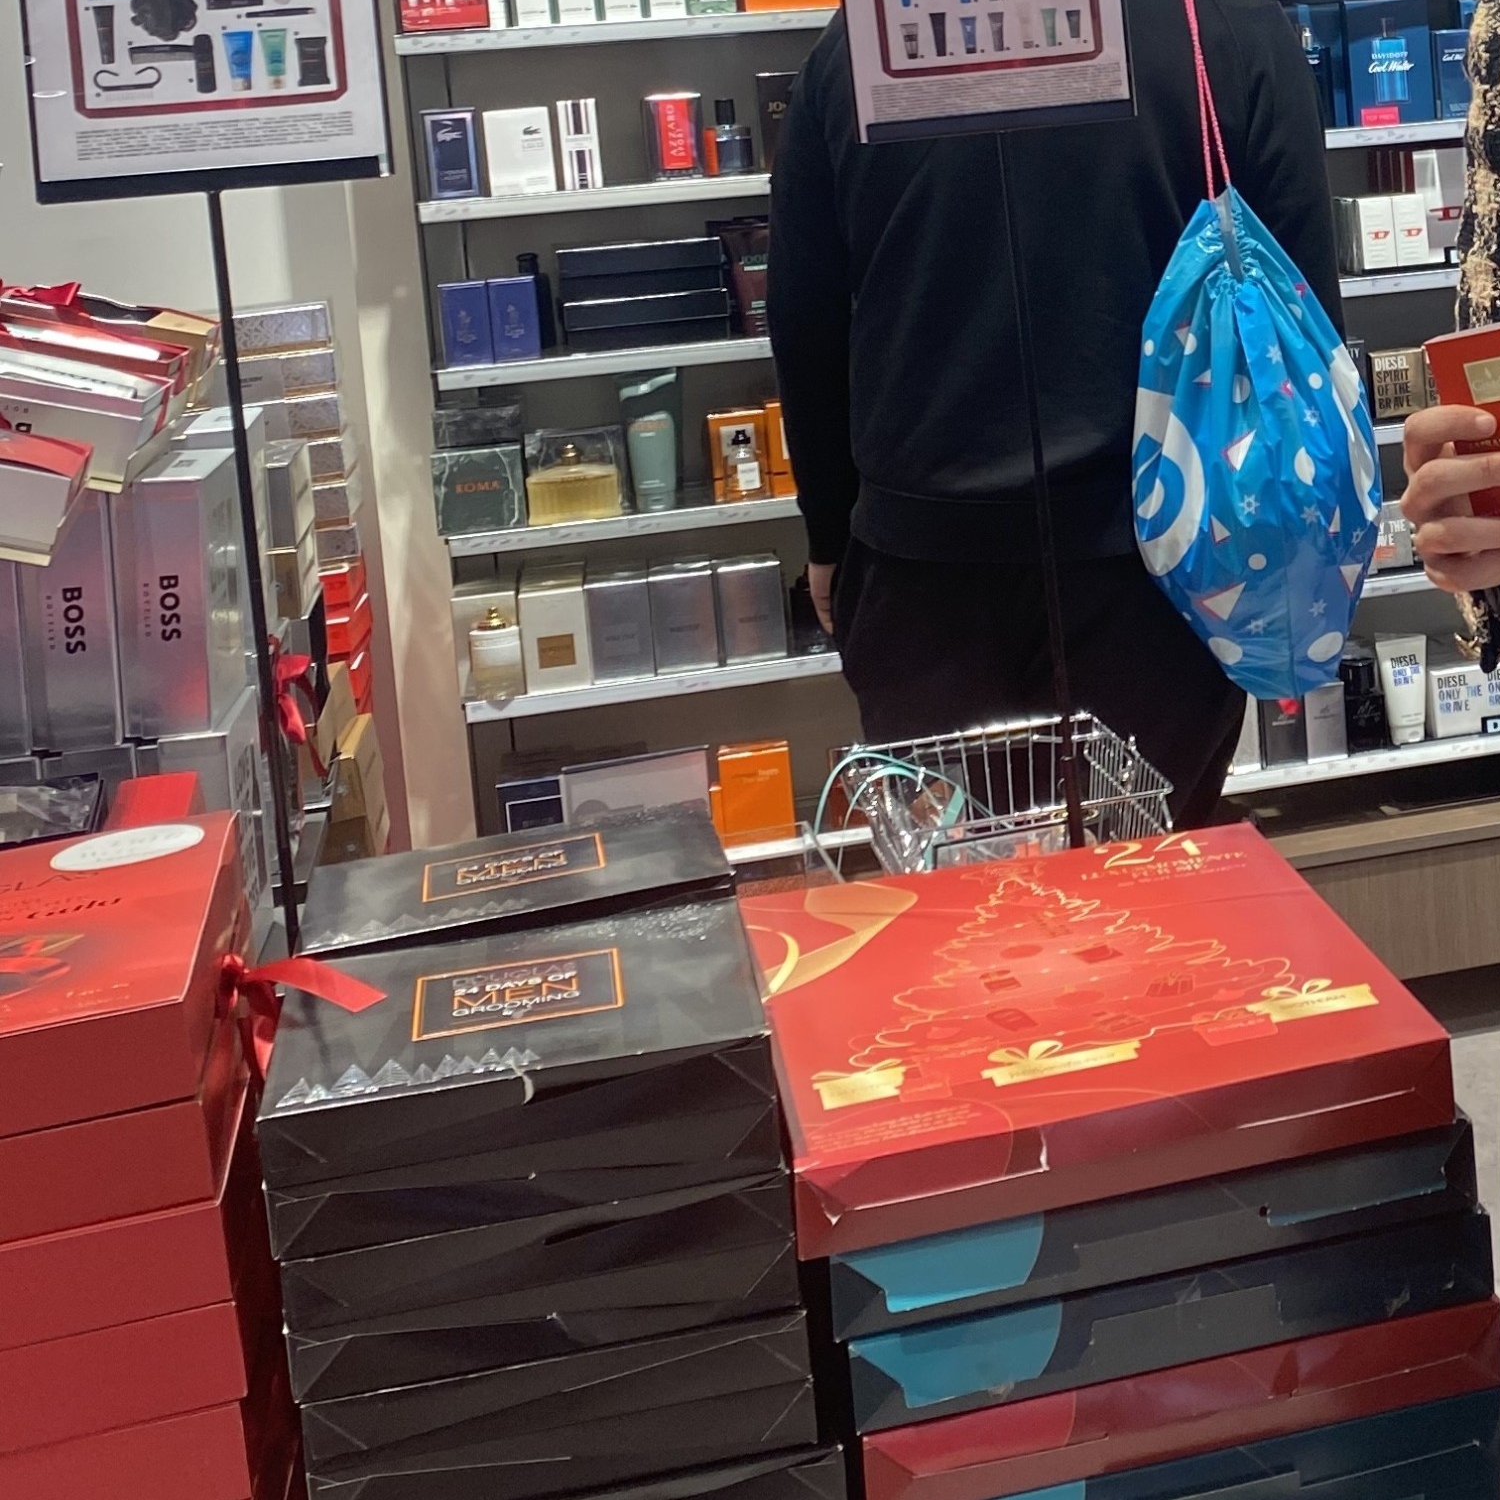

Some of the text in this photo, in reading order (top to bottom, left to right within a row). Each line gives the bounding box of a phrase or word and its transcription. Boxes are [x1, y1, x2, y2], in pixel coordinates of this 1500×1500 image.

[1368, 61, 1415, 74] Cool Water
[666, 103, 678, 157] AZZARO
[1374, 355, 1410, 372] DIESEL
[1376, 368, 1410, 384] SPIRIT
[1377, 381, 1411, 397] OF THE
[1378, 395, 1412, 410] BRAVE
[1388, 519, 1407, 533] THE
[159, 575, 181, 642] BOSS
[62, 586, 86, 654] BOSS
[1390, 654, 1419, 669] DIESEL
[1392, 666, 1421, 678] ONLY THE
[1393, 676, 1414, 687] BRAVE
[1437, 674, 1468, 690] DIESEL
[1438, 685, 1483, 701] ONLY THE
[1438, 700, 1470, 714] BRAVE
[1093, 831, 1209, 869] 24
[454, 970, 578, 996] 24 DAYS OF
[453, 976, 579, 1010] MEN
[452, 990, 580, 1017] GROOMING
